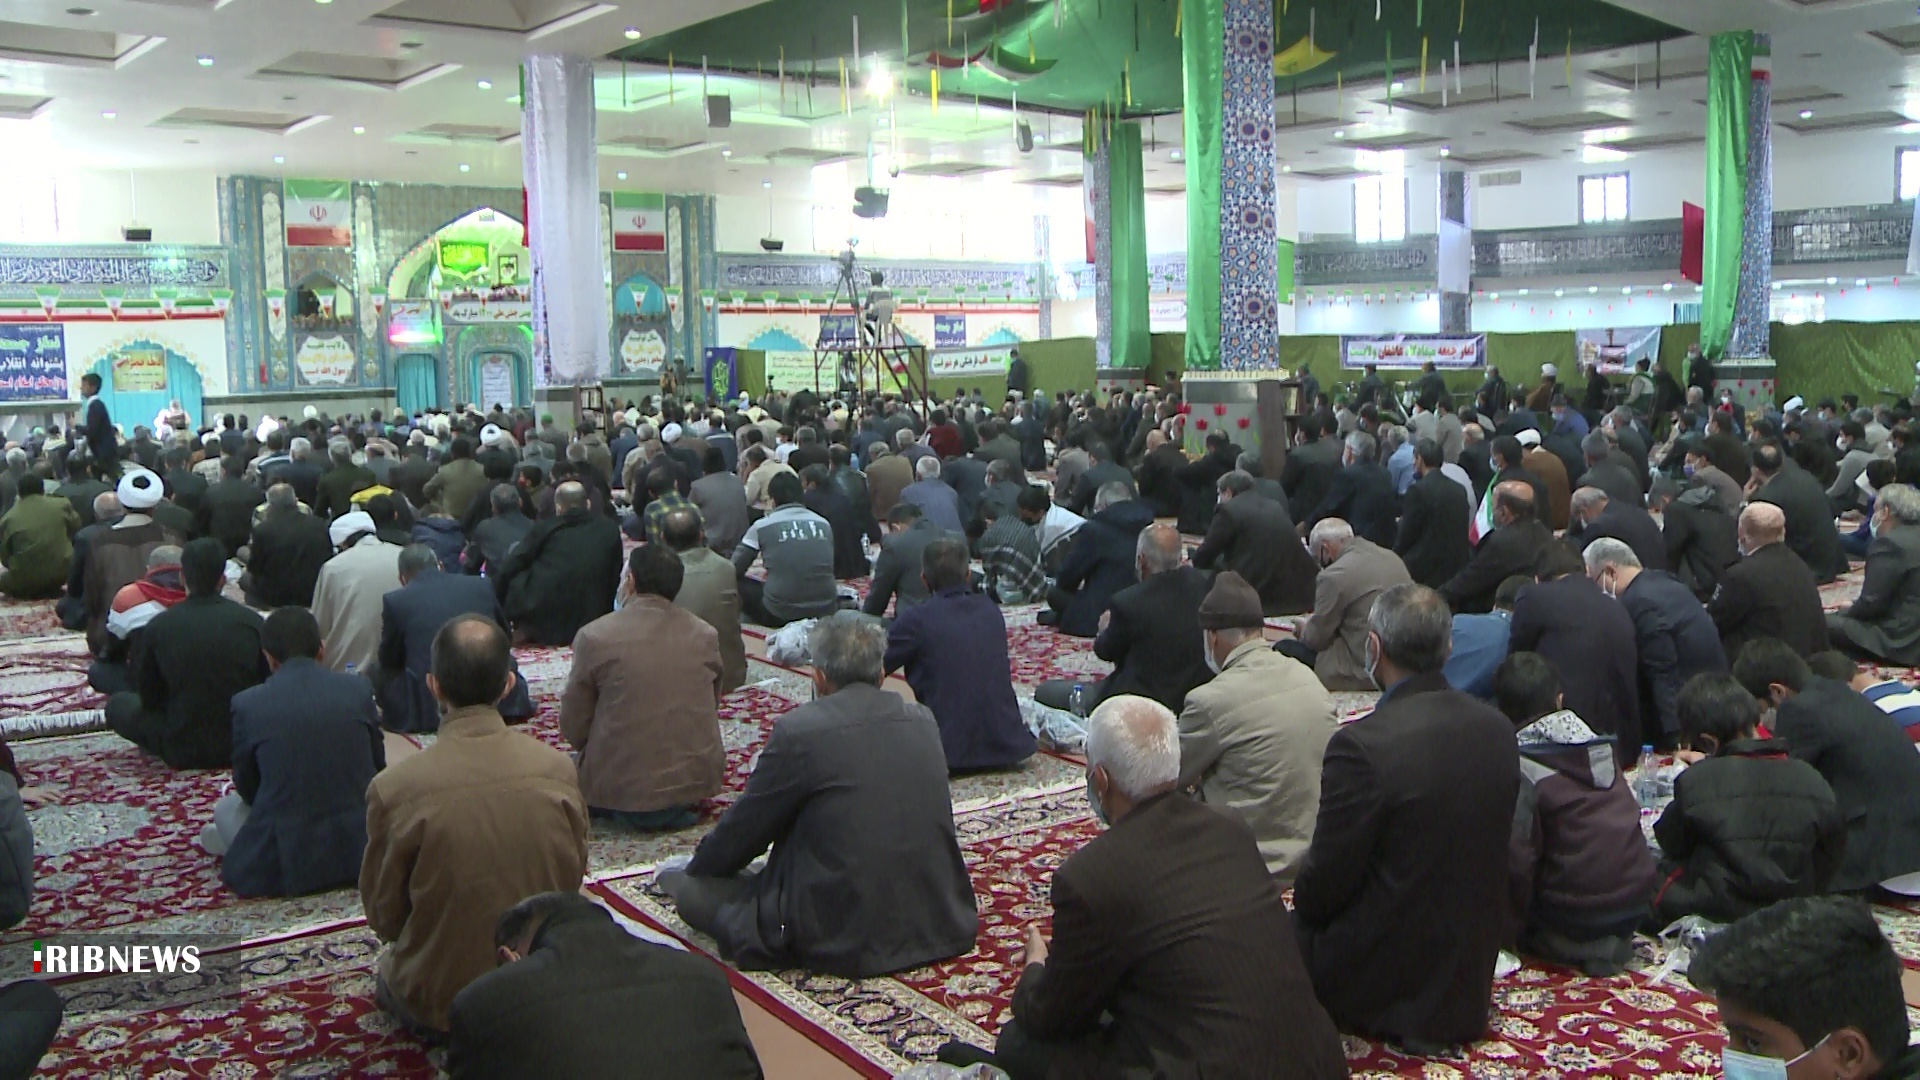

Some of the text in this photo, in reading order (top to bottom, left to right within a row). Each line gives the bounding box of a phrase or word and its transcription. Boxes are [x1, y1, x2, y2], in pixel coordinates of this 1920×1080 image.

[34, 335, 60, 355] نماز
[1350, 344, 1377, 359] ولایت
[1378, 344, 1404, 360] عاشقان
[1437, 346, 1457, 359] جمعه
[1459, 344, 1475, 359] نماز
[31, 356, 64, 373] پشتوانه
